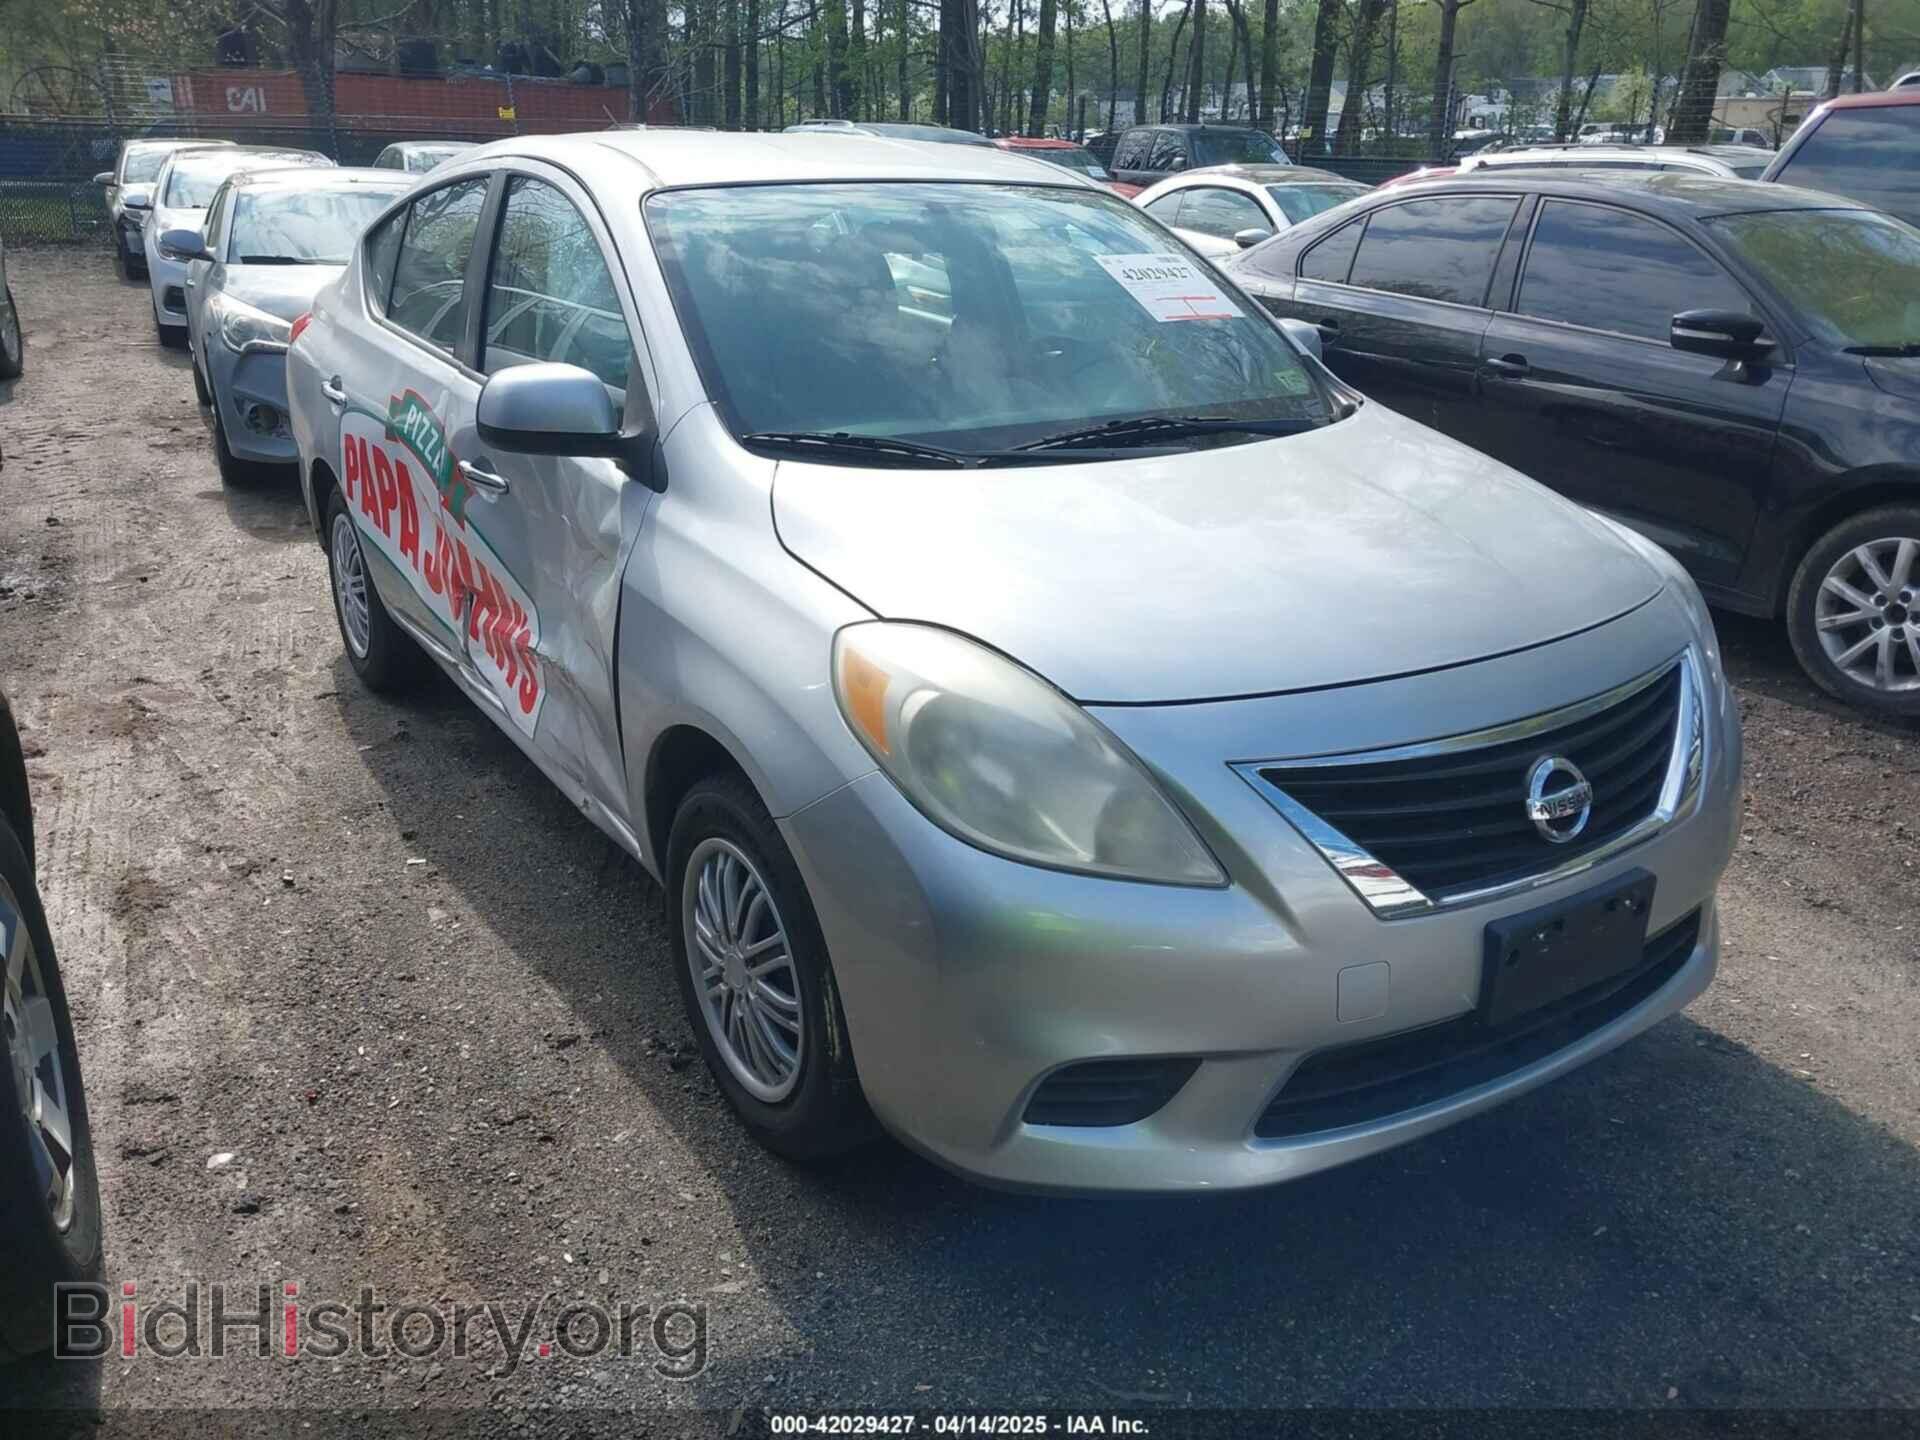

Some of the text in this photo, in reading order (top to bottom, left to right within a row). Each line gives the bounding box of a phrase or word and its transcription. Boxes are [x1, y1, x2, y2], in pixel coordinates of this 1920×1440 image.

[404, 404, 446, 478] PIZZA
[344, 432, 421, 573] PAPA
[1536, 786, 1587, 817] NISS
